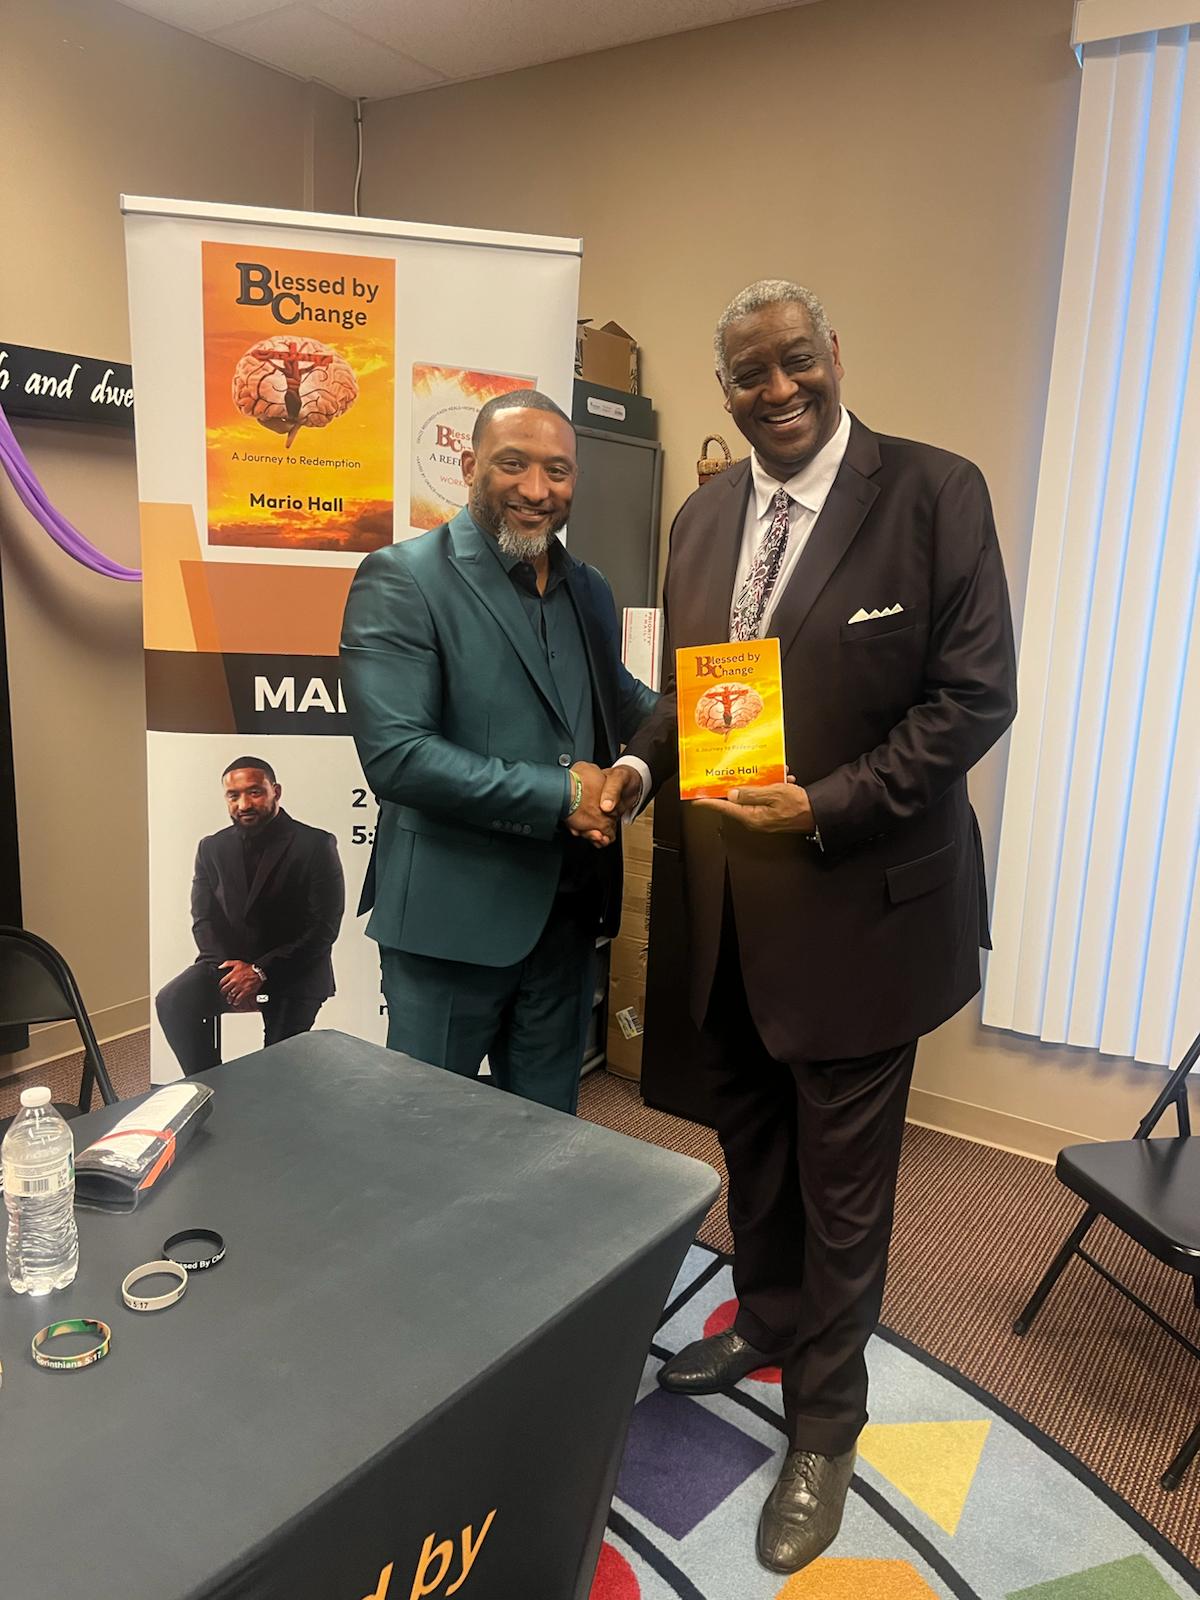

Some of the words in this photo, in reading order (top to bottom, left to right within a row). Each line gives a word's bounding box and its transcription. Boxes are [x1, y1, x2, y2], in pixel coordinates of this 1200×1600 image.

[235, 263, 345, 306] Blessed
[352, 277, 379, 303] by
[271, 292, 367, 329] Change
[24, 363, 82, 399] and
[90, 368, 134, 408] dwe
[435, 424, 471, 447] Bless
[232, 452, 240, 461] A
[241, 453, 283, 465] Journey
[286, 456, 297, 464] to
[299, 456, 361, 469] Redemption
[430, 453, 437, 461] A
[440, 476, 468, 488] WORK
[249, 492, 303, 510] Mario
[308, 496, 343, 512] Hall
[695, 653, 744, 677] Blessed
[747, 652, 760, 663] by
[712, 665, 754, 679] Change
[254, 676, 347, 713] MA
[705, 767, 735, 776] Mario
[737, 765, 758, 774] Hall
[352, 789, 367, 808] 2
[352, 825, 377, 845] 5:
[199, 1259, 210, 1269] By
[35, 1354, 82, 1369] Corinthians
[409, 1508, 497, 1600] by
